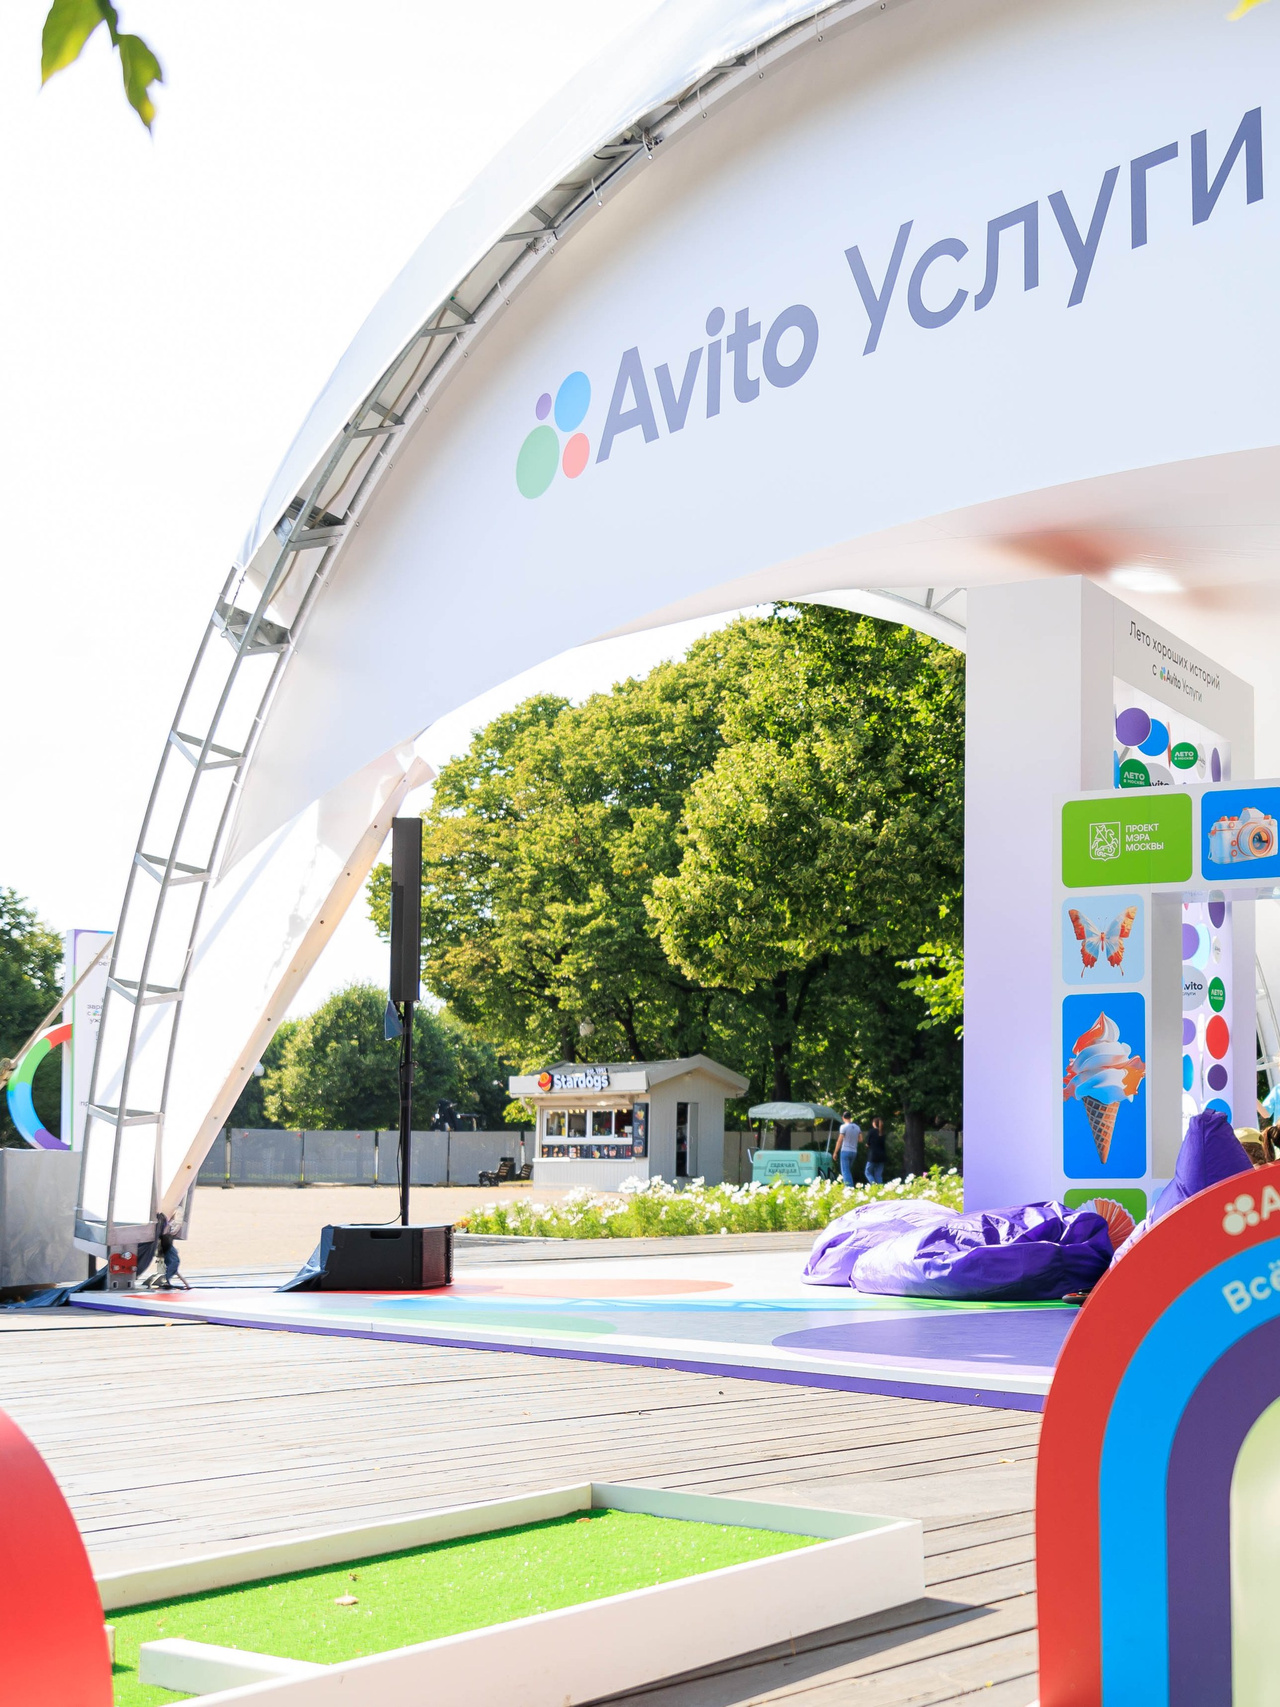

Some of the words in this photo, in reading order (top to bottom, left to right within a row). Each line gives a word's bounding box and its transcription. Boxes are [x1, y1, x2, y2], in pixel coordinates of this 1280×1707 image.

[595, 304, 820, 464] Avito
[843, 106, 1264, 356] Услуги
[1129, 620, 1151, 647] Лето
[1152, 638, 1189, 671] хороших
[1189, 661, 1221, 690] историй
[1165, 669, 1182, 690] Avito
[1182, 678, 1203, 702] Услуги
[1123, 771, 1146, 781] ЛЕТО
[1125, 823, 1160, 833] ПРОЕКТ
[1125, 833, 1151, 843] МЭРА
[1125, 842, 1165, 852] МОСКВЫ
[1183, 981, 1204, 991] vito
[553, 1073, 610, 1092] Stardogs
